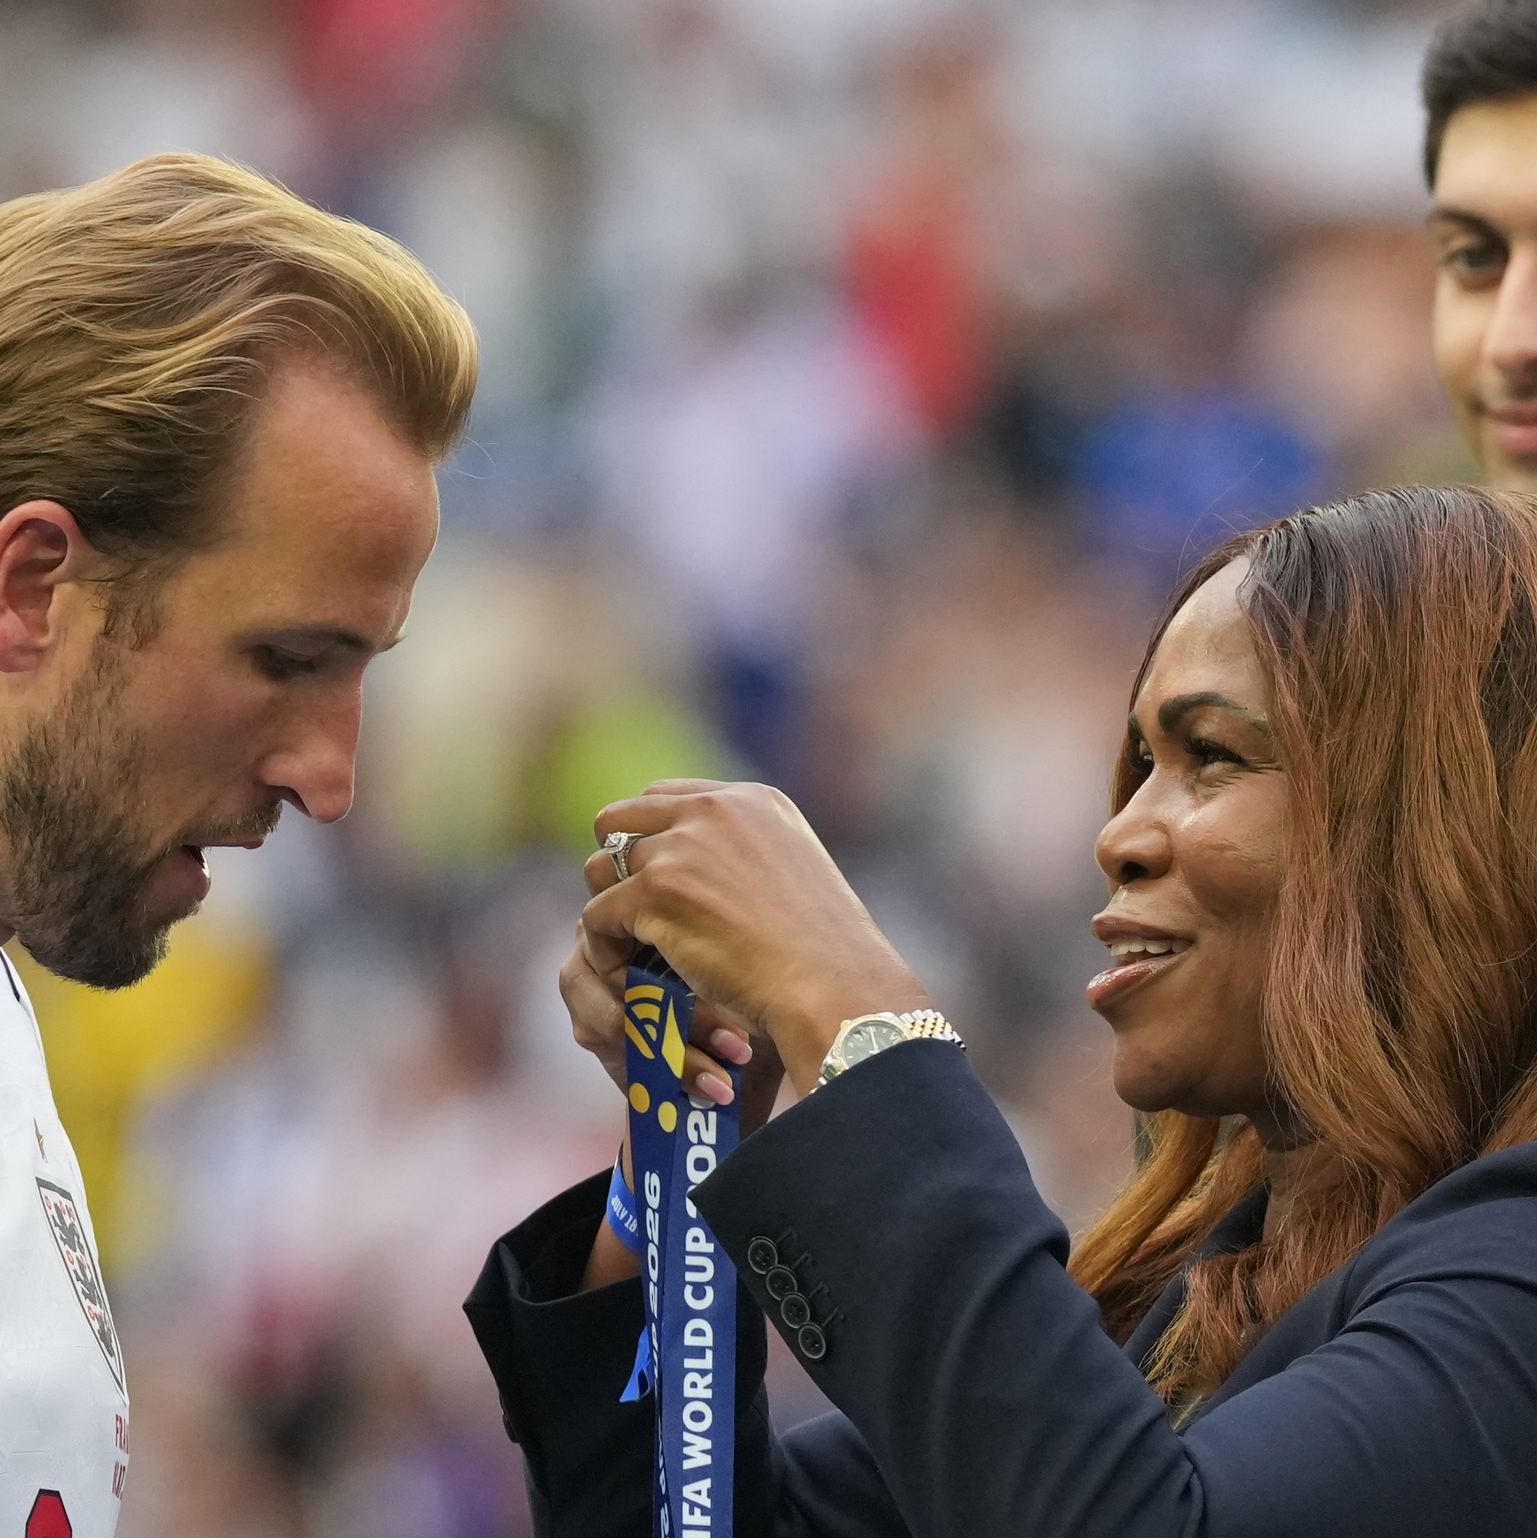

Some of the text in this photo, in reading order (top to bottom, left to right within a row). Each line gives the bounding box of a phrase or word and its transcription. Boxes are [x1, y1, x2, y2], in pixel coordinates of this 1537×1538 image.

[624, 1213, 638, 1233] 18
[644, 1170, 660, 1319] 2026
[684, 1227, 714, 1310] CUP
[682, 1318, 714, 1470] WORLD
